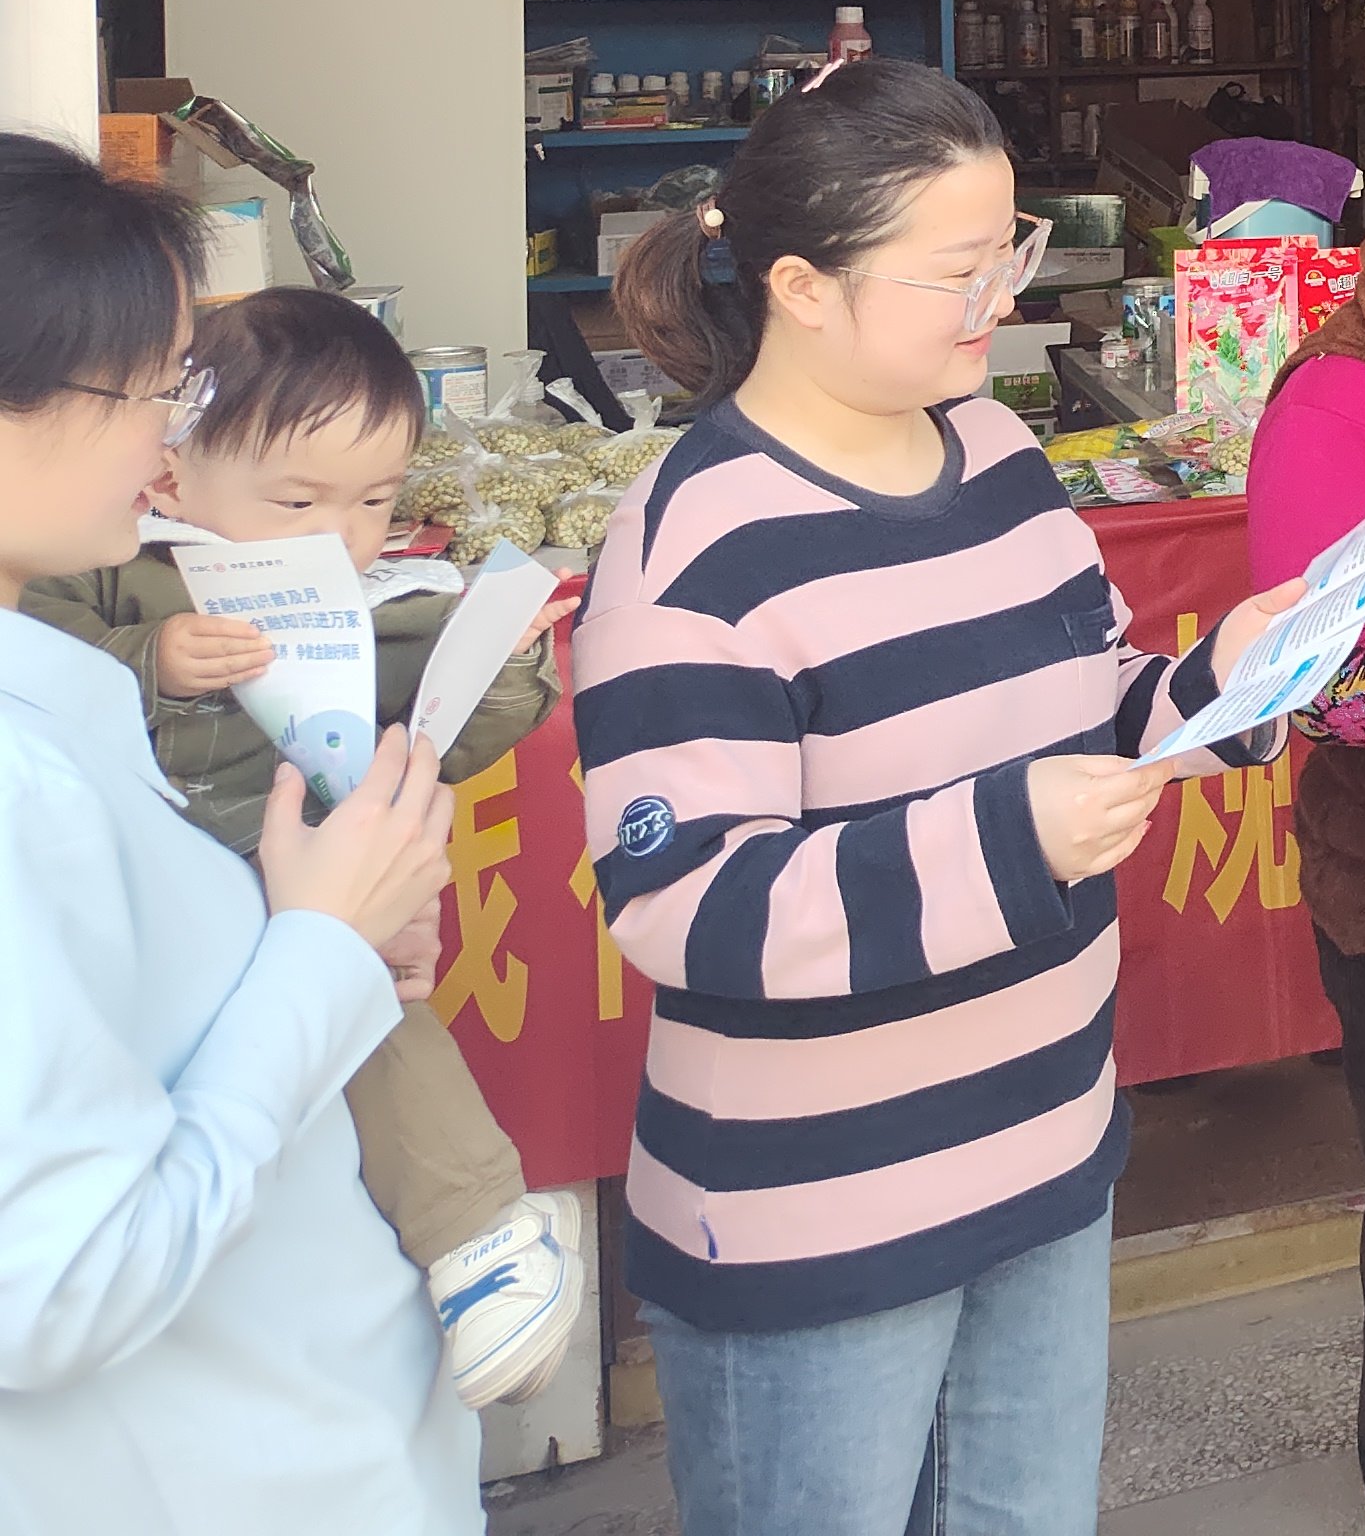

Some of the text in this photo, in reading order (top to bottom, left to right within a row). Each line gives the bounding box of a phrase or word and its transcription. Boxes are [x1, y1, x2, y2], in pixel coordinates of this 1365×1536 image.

[203, 586, 322, 615] 金融知识普及月
[250, 609, 362, 633] 金融知识进万家
[462, 1229, 514, 1267] TIRED
